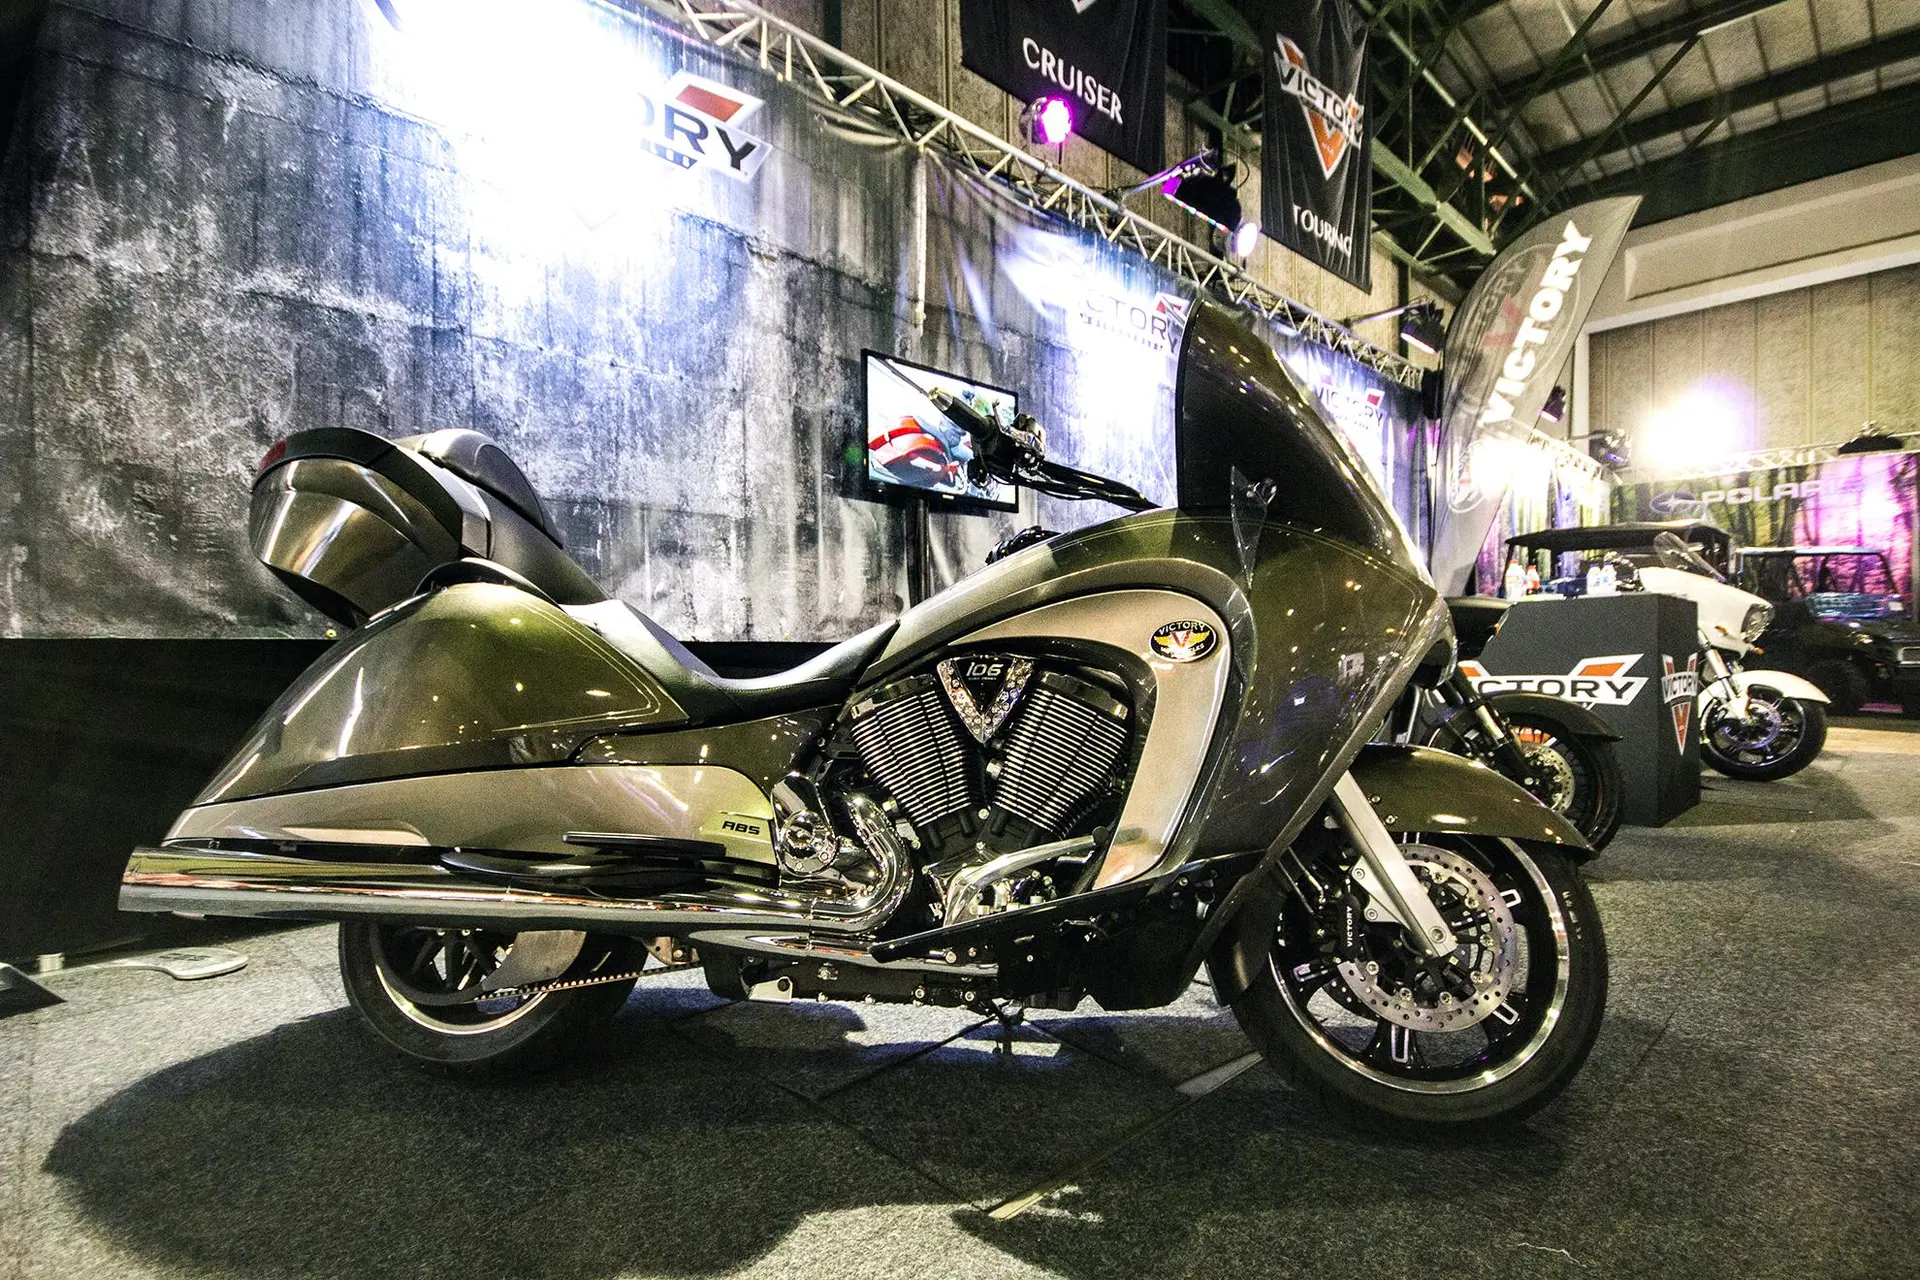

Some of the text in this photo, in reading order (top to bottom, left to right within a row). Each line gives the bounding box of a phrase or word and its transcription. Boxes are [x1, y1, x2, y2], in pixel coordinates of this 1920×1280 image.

[1022, 37, 1123, 124] CRUISER
[1480, 219, 1592, 425] VICTORY
[1701, 479, 1825, 505] POLAR
[1159, 621, 1205, 635] VICTORY
[966, 661, 1004, 677] 106
[1477, 679, 1635, 700] CTORY
[1662, 674, 1698, 699] VICTORY
[721, 820, 760, 836] ABS
